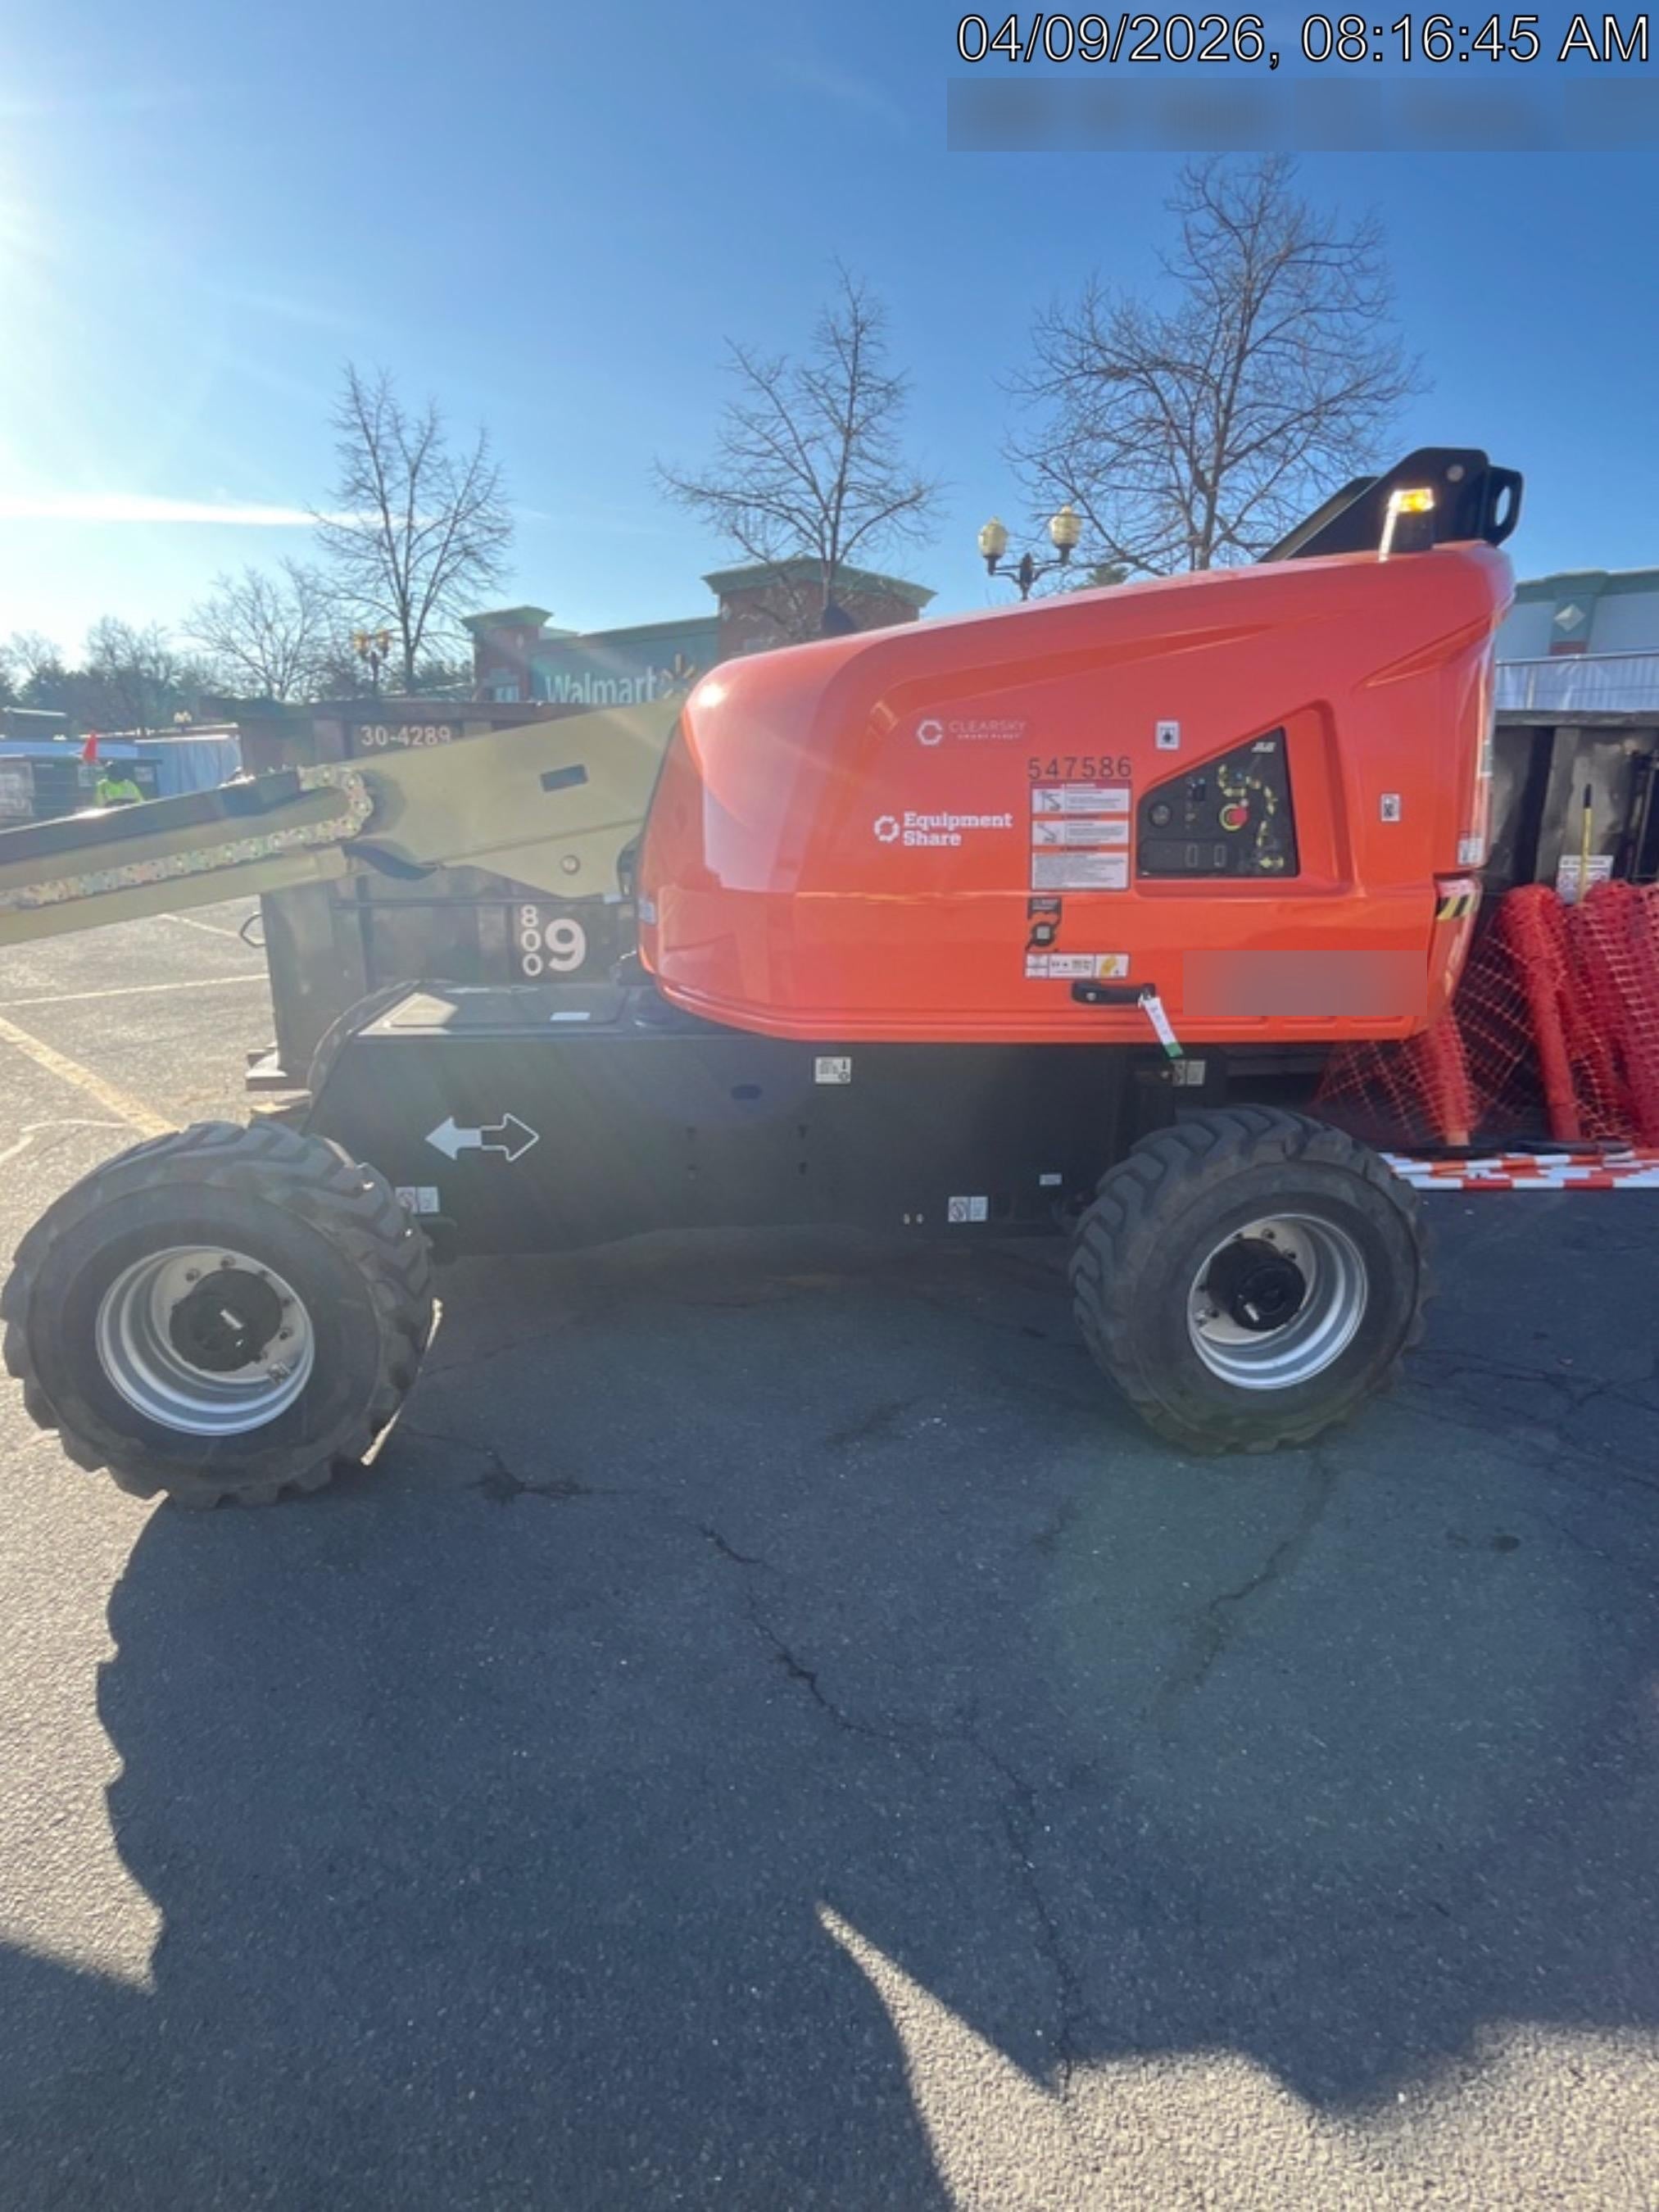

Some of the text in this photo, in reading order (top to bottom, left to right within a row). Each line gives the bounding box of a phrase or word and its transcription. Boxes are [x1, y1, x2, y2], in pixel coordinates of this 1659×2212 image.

[545, 665, 656, 705] Walmart
[360, 725, 452, 746] 30-4289
[1028, 756, 1131, 779] 547586
[904, 812, 1013, 831] Equipment
[904, 830, 962, 846] Share
[545, 918, 586, 972] 9
